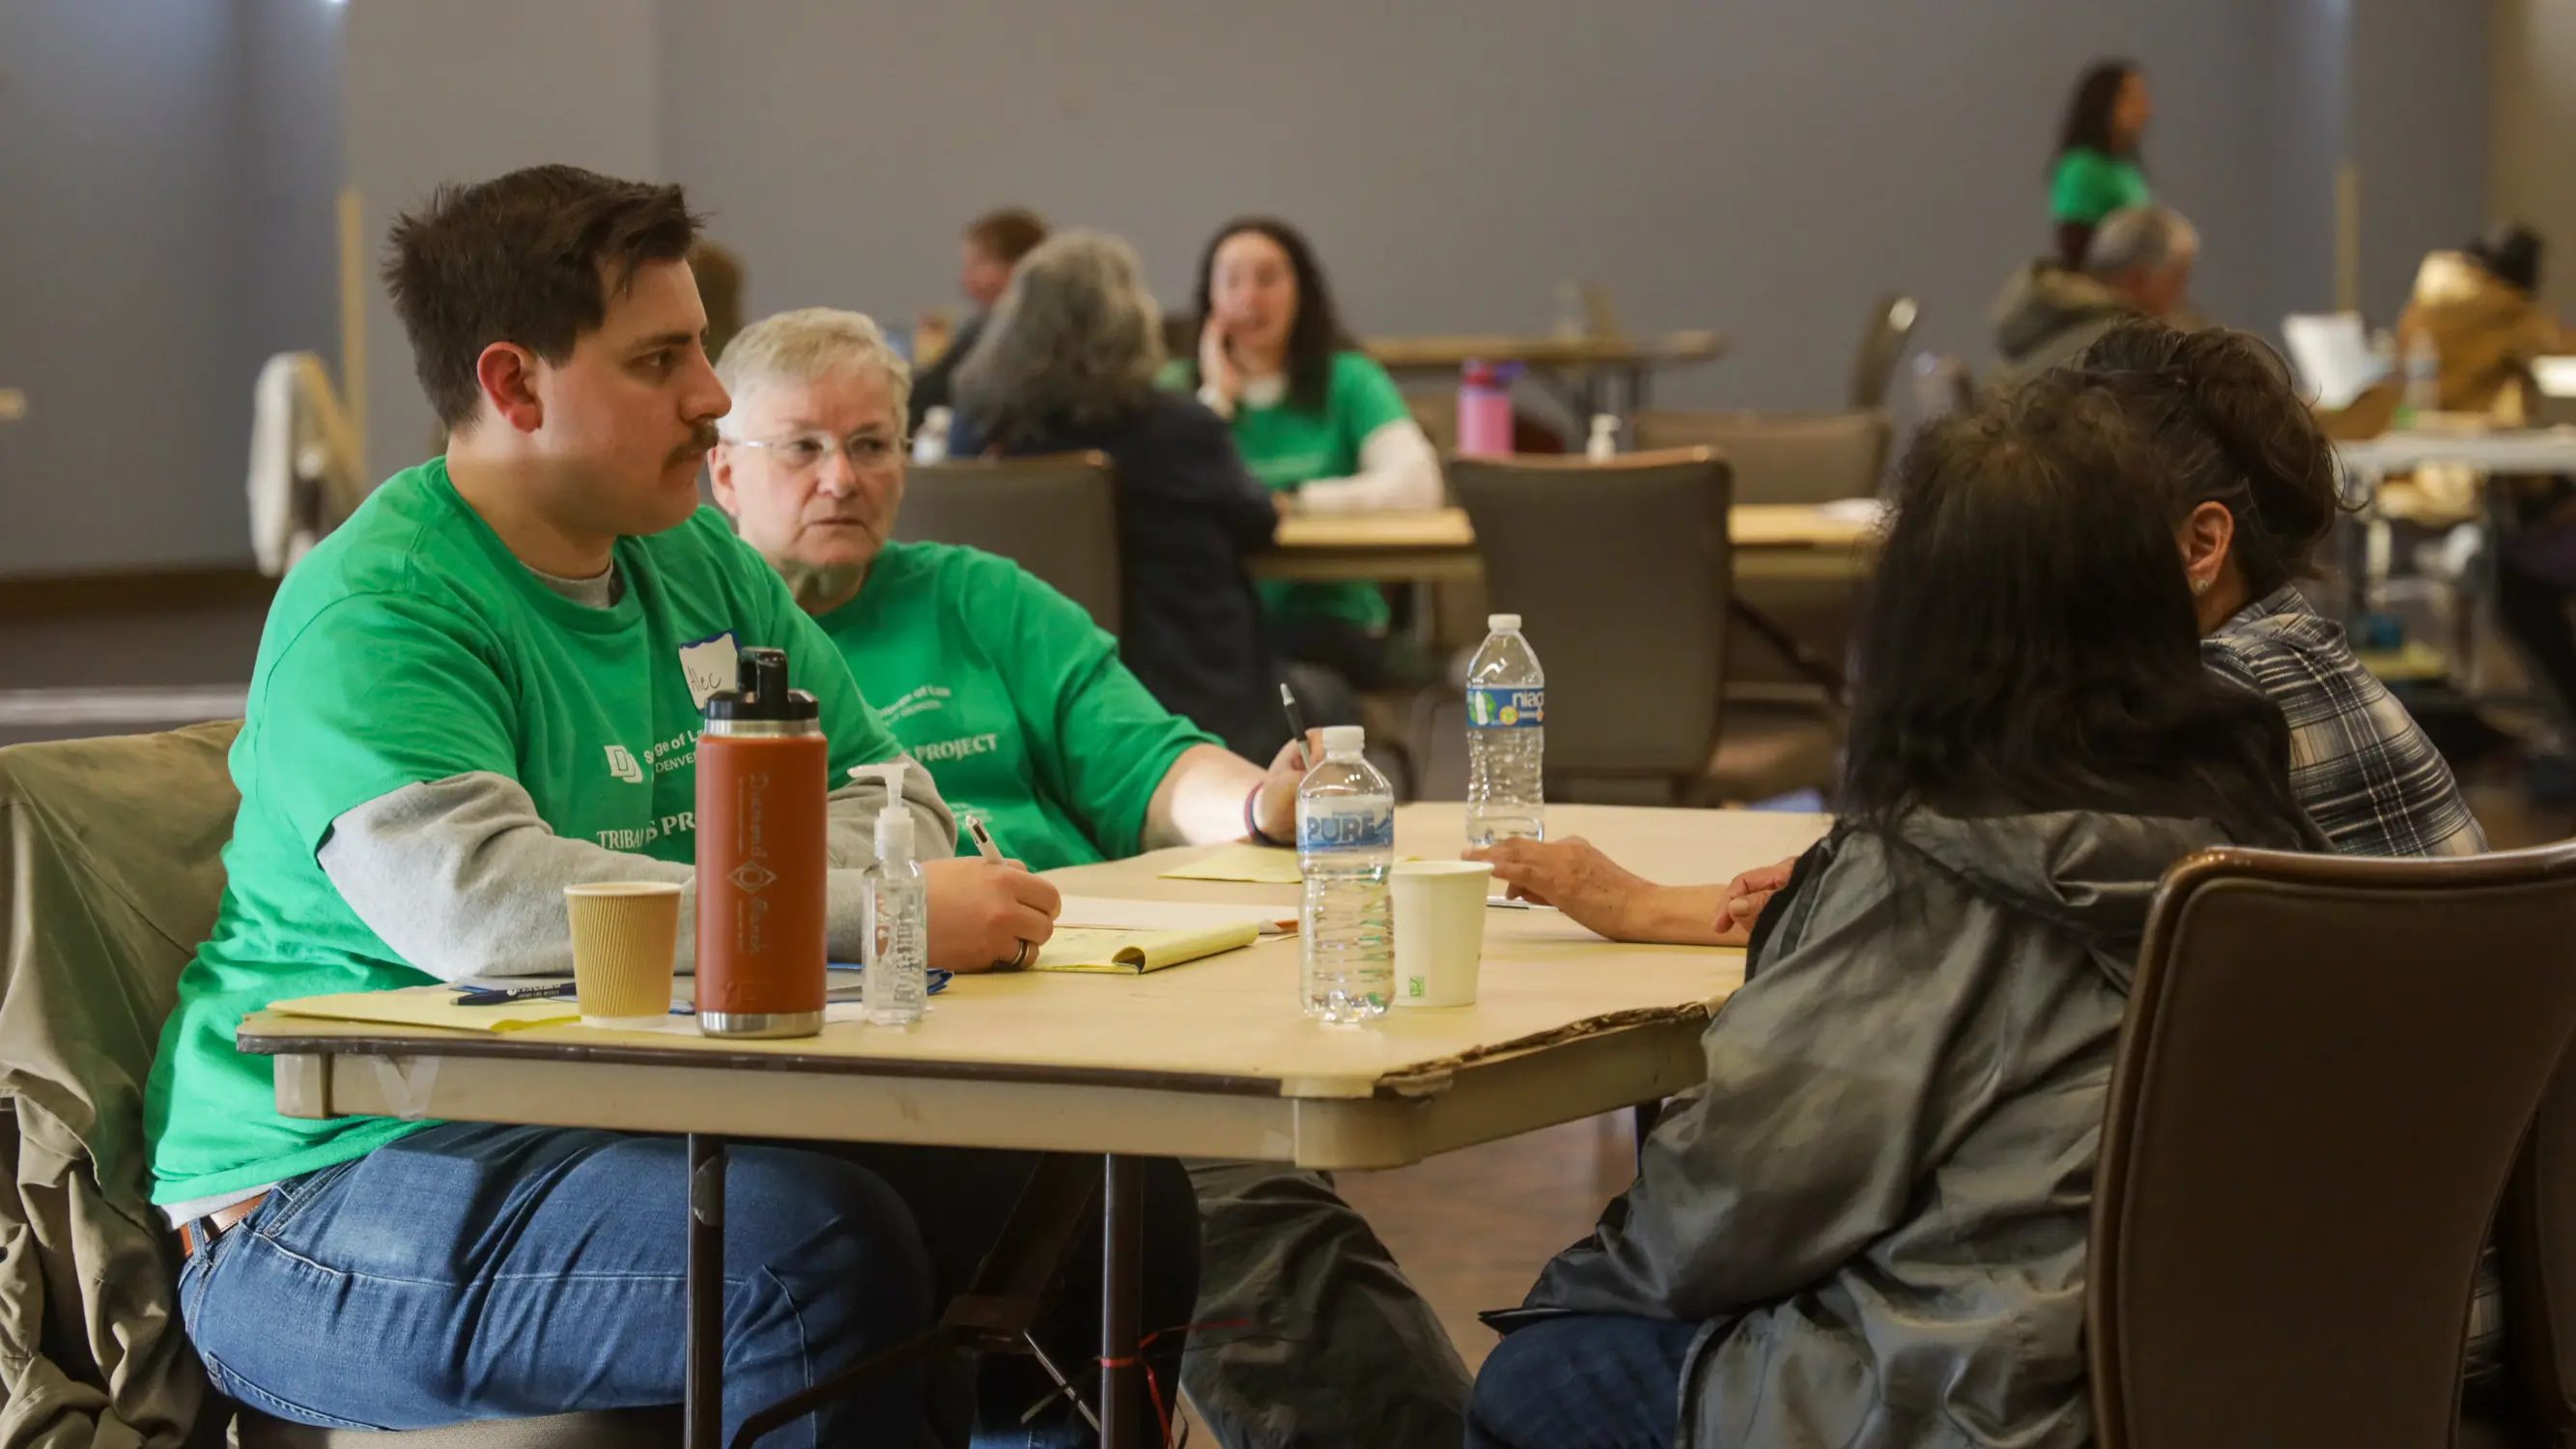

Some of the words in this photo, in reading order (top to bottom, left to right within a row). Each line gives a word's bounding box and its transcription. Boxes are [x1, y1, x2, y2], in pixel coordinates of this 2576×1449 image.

[670, 732, 685, 750] of
[915, 733, 997, 761] PROJECT
[655, 751, 696, 773] DENVE
